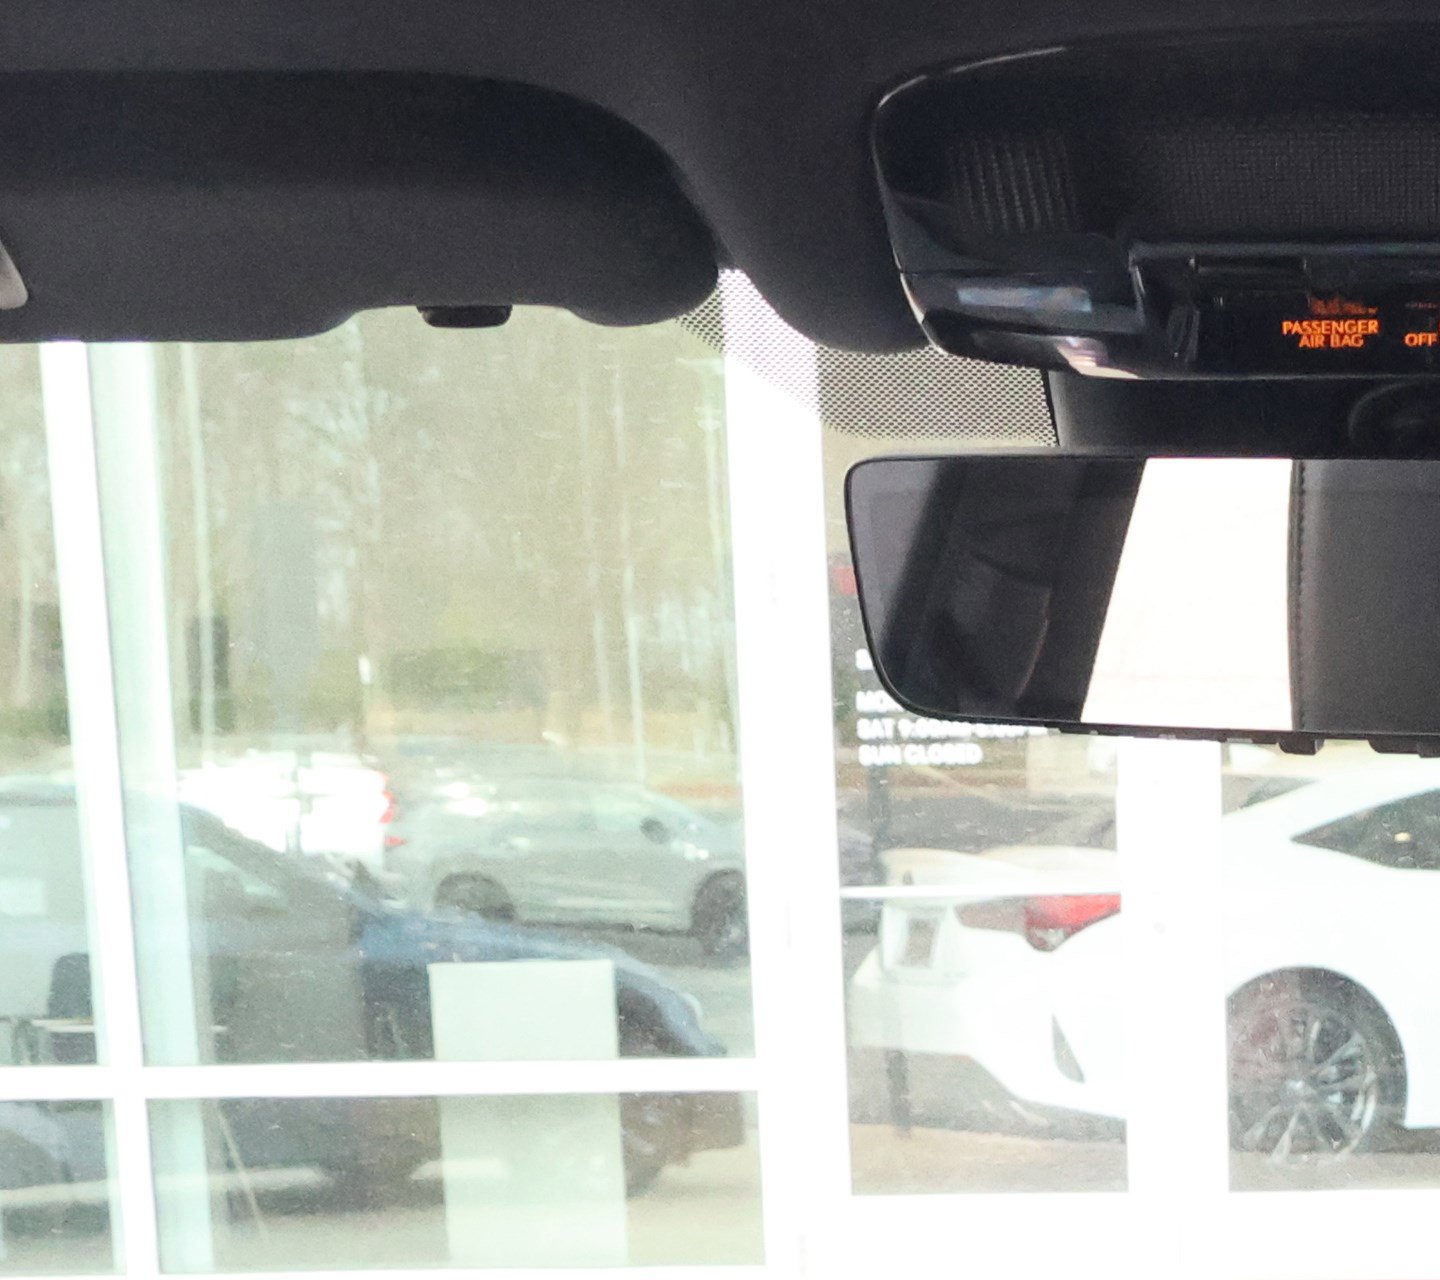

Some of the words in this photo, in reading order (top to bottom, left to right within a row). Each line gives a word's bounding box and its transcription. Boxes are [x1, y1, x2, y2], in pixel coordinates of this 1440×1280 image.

[1281, 319, 1379, 335] PASSENGER
[1298, 333, 1327, 348] AIR
[1404, 333, 1437, 347] OFF
[903, 742, 984, 765] CLOSED
